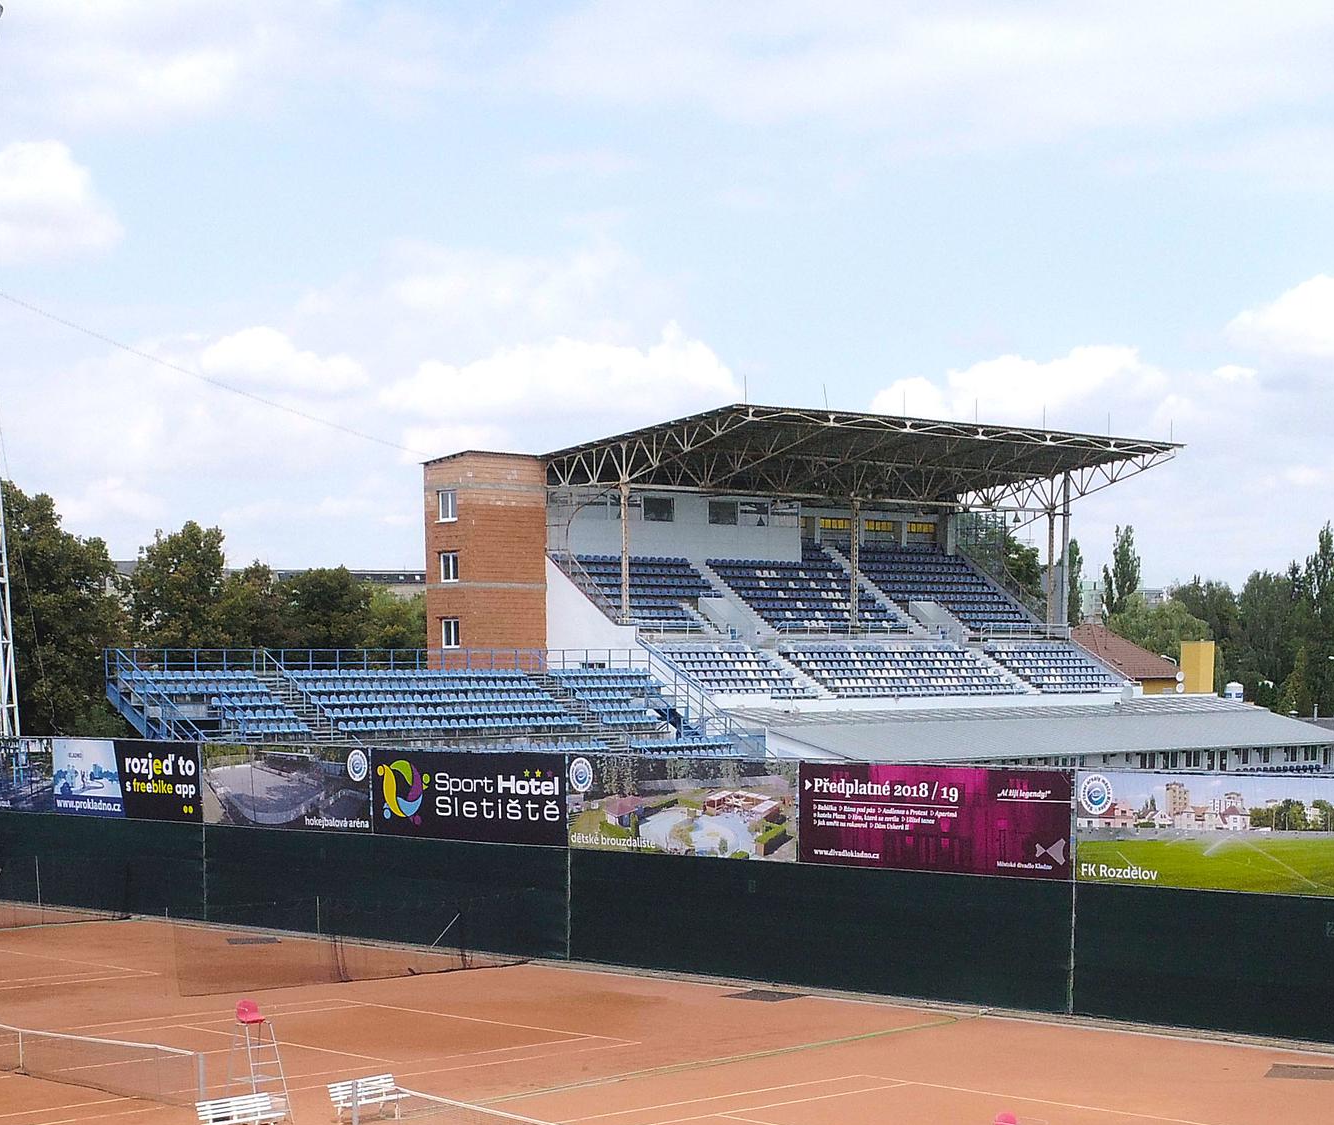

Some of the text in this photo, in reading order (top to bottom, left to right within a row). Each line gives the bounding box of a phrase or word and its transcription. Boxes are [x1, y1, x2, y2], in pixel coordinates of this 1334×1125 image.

[125, 752, 195, 779] rozjeď to
[125, 778, 196, 799] s freebike app
[435, 772, 494, 795] Sport
[497, 774, 560, 796] Hotel
[813, 778, 890, 798] Předplatné
[893, 782, 929, 798] 2018
[940, 786, 959, 802] 19
[56, 798, 122, 813] www.prokladno.cz
[435, 796, 560, 822] Sletiště
[349, 817, 369, 829] aréna
[571, 832, 600, 845] dětské
[1081, 863, 1158, 880] FK Rozdělov
